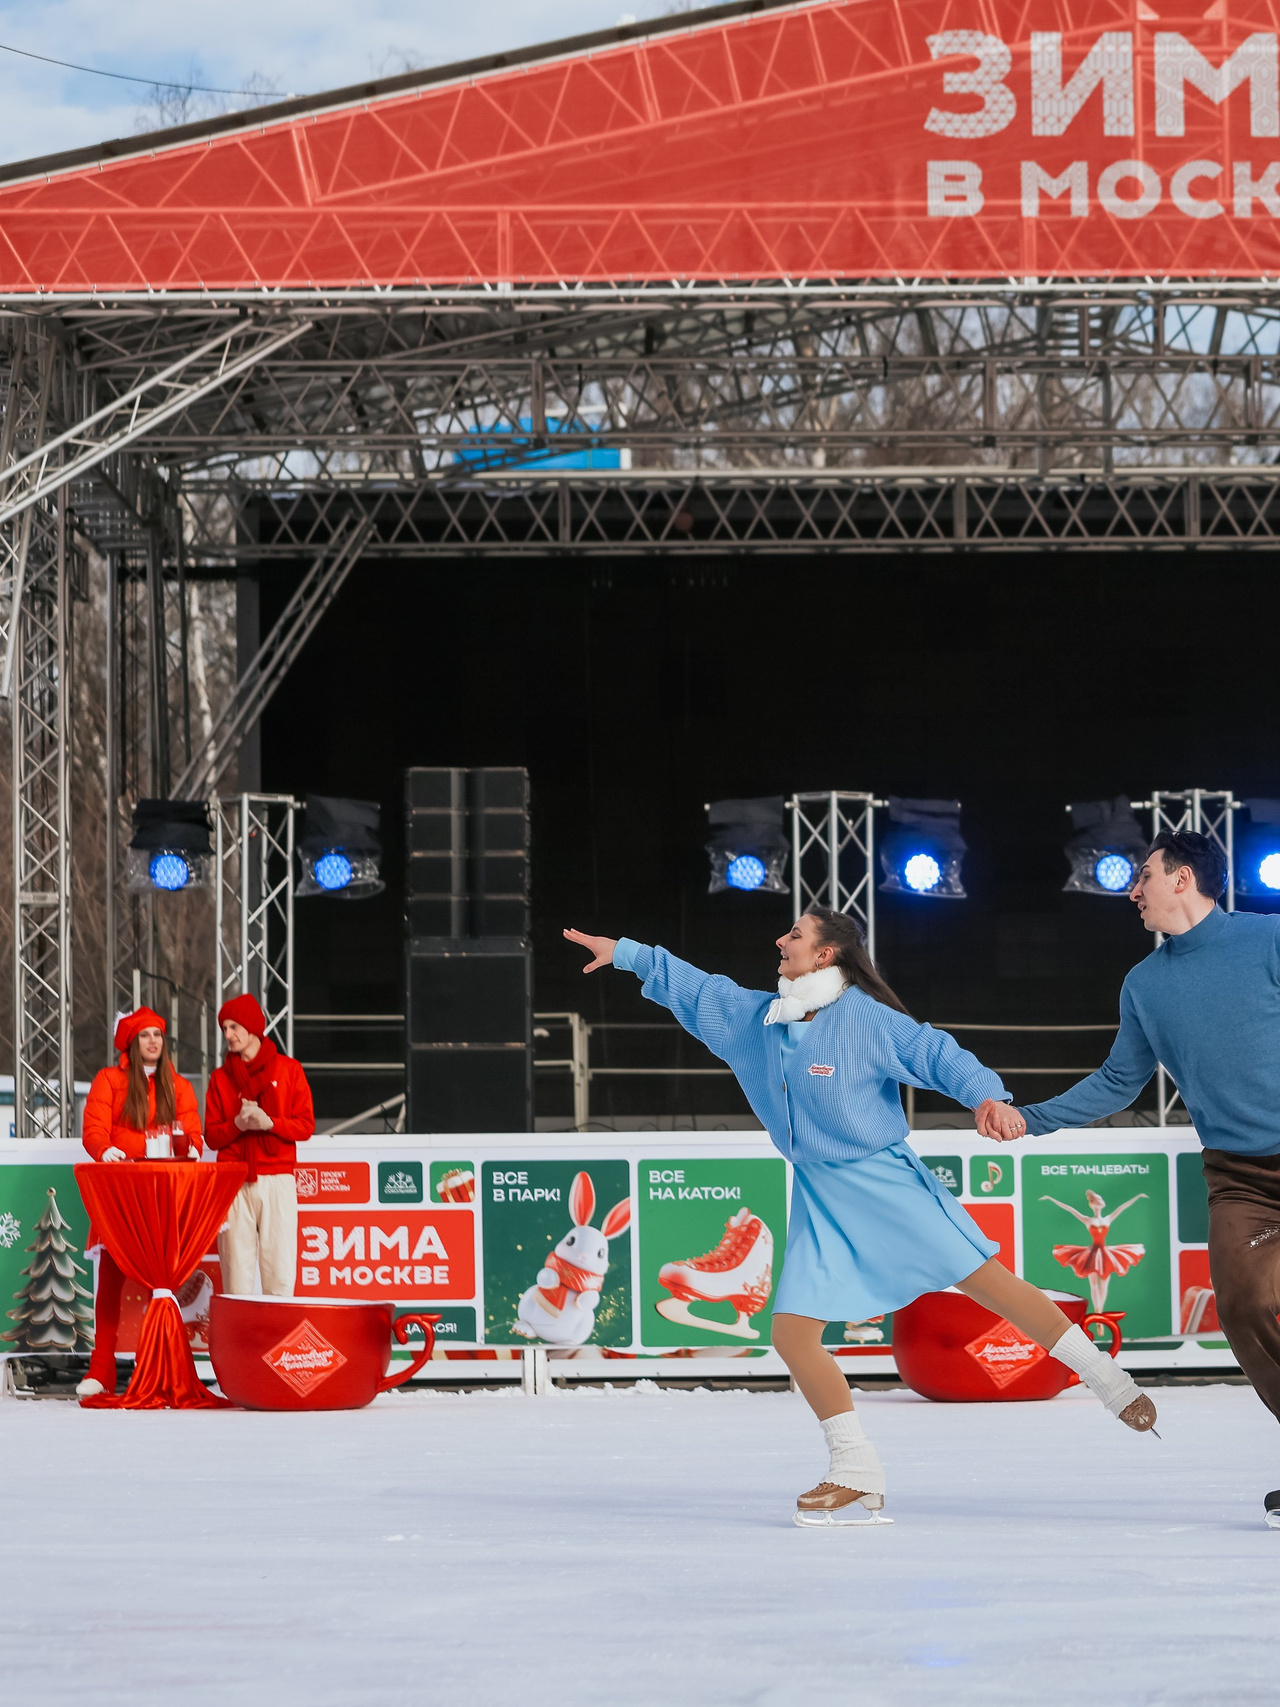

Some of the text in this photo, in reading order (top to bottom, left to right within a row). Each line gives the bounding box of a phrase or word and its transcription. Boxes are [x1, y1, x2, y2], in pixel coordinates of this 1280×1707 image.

[927, 160, 985, 218] В
[320, 1171, 347, 1179] ПРОЕКТ
[649, 1170, 685, 1184] ВСЕ
[1041, 1164, 1150, 1176] ВСЕ ТАНЦЕВАТЬ!
[493, 1171, 529, 1186] ВСЕ
[493, 1188, 561, 1202] В ПАРК!
[649, 1186, 741, 1201] НА КАТОК!
[301, 1225, 450, 1262] ЗИМА
[302, 1265, 450, 1286] В МОСКВЕ
